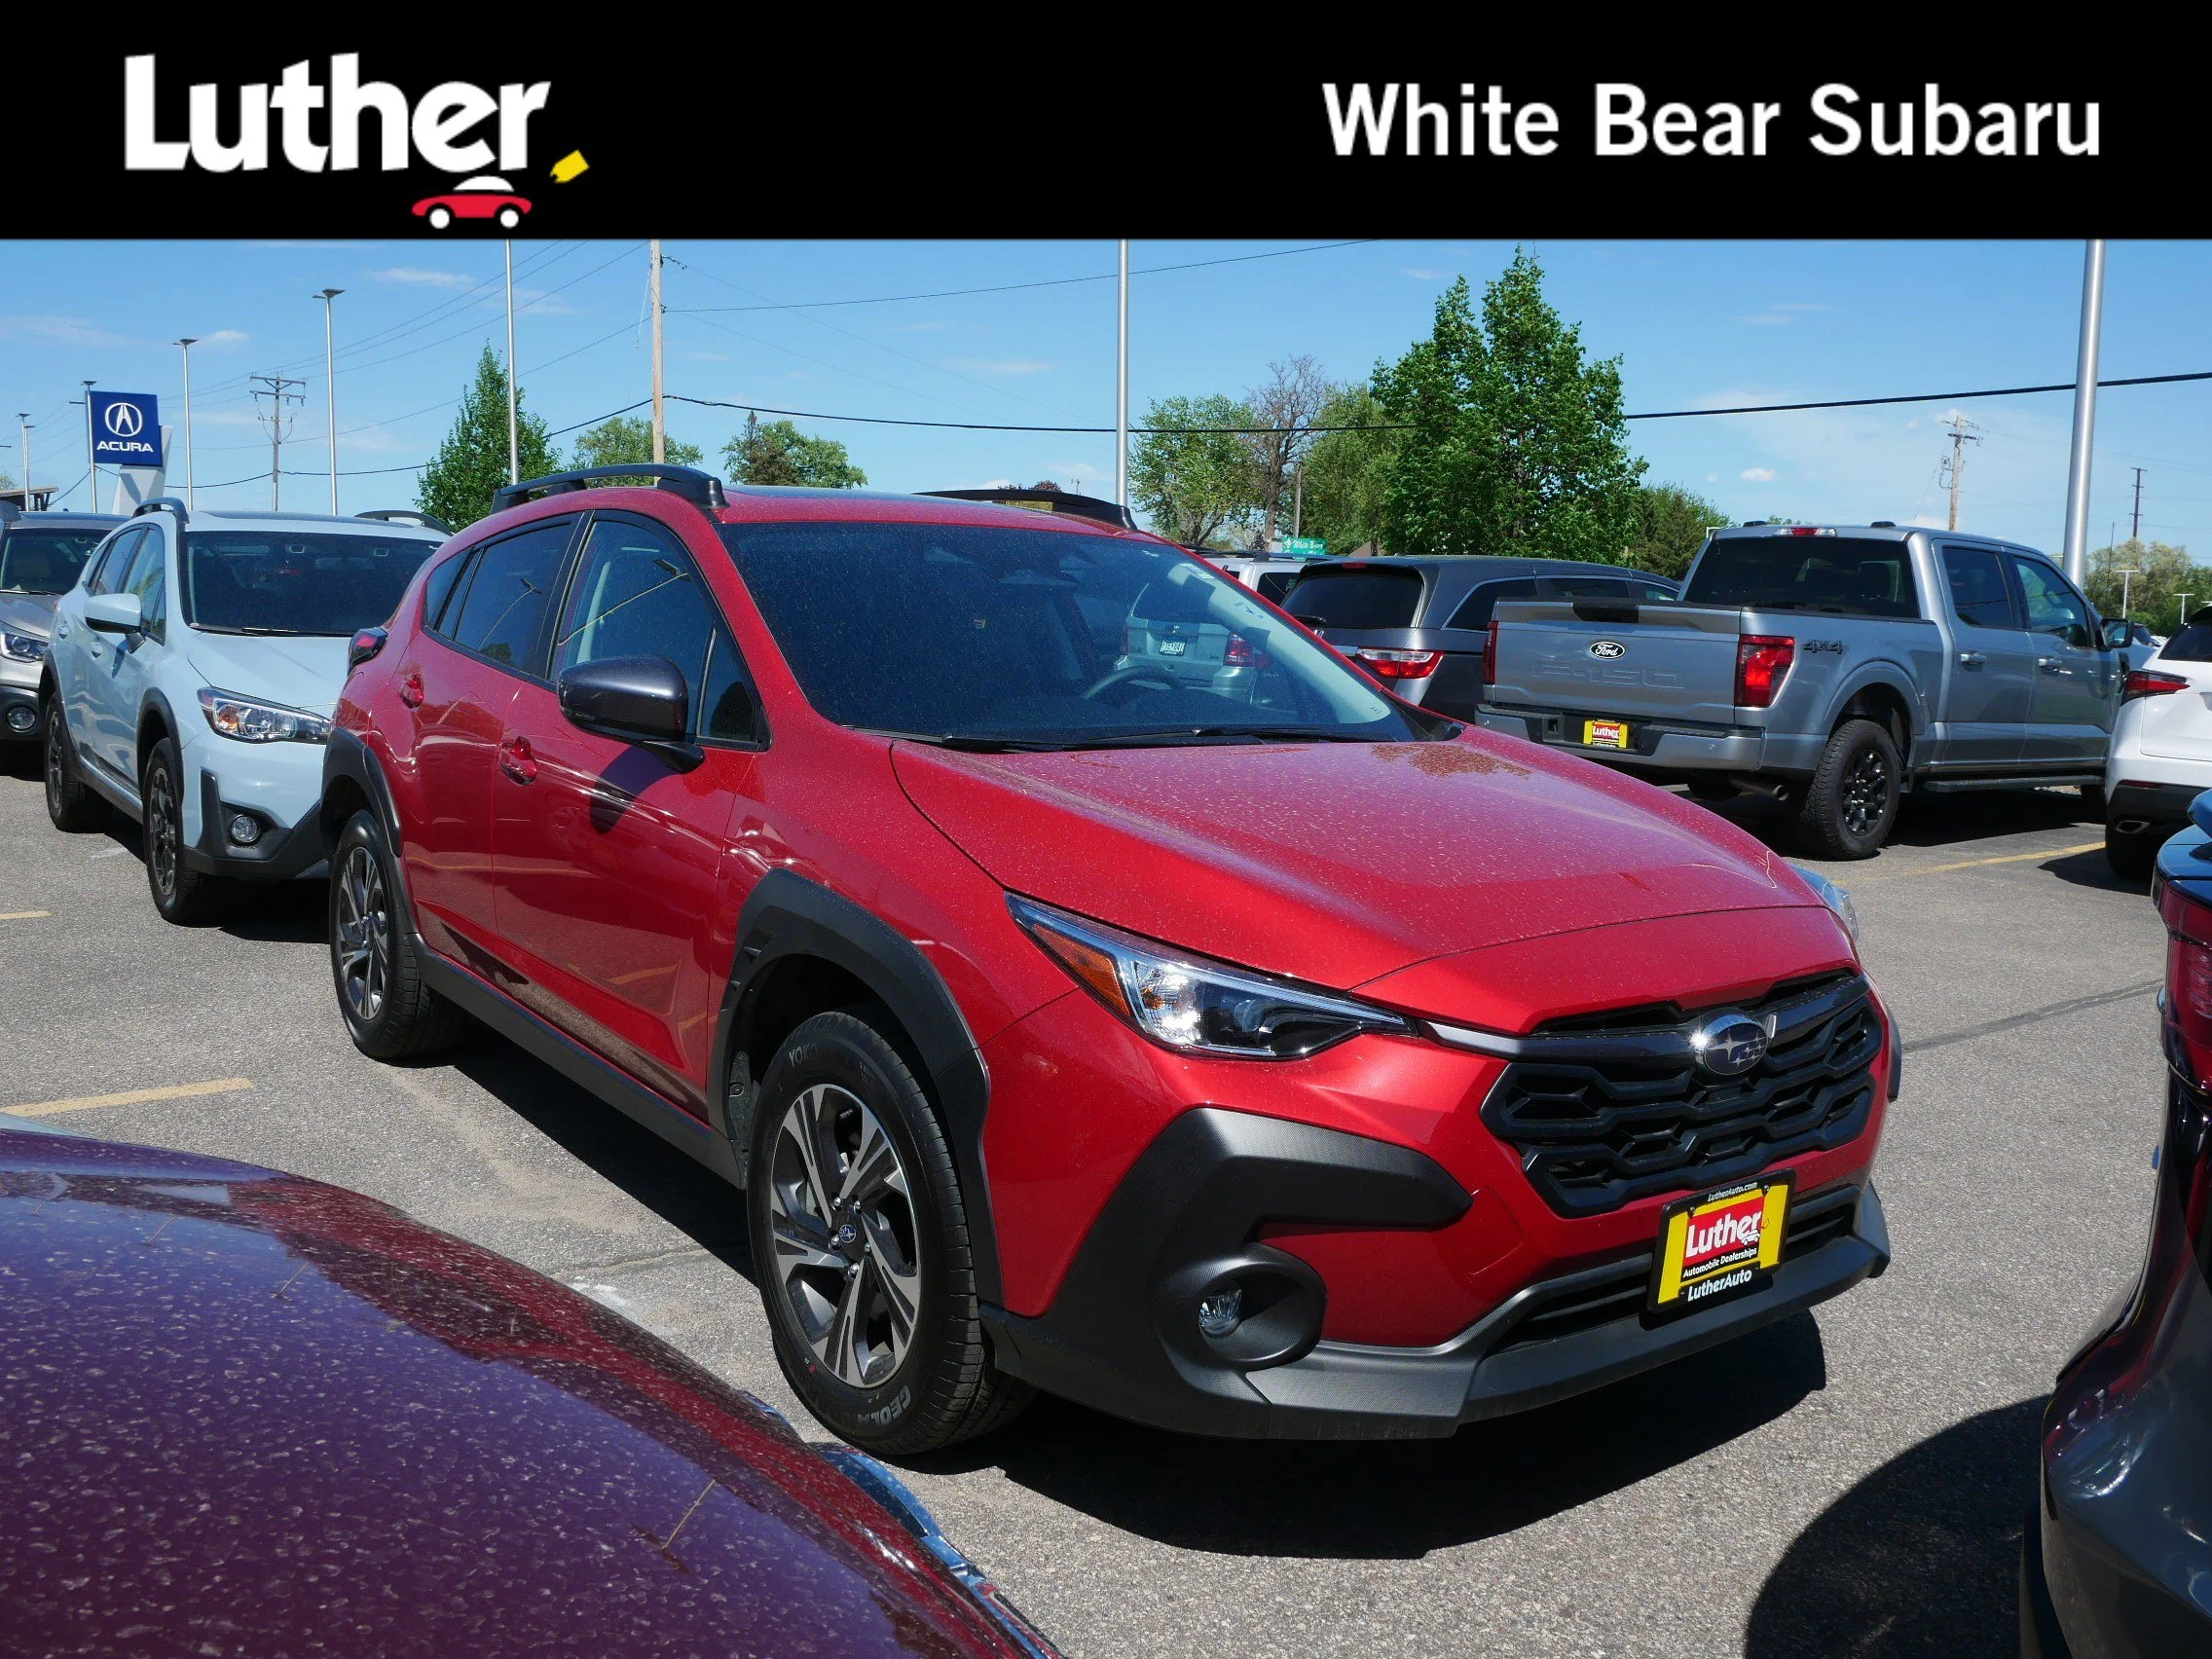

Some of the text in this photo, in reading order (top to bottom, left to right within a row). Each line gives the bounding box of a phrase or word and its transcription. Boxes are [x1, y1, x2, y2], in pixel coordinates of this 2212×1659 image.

[96, 440, 154, 453] ACURA
[1595, 644, 1618, 657] Ford
[1592, 725, 1620, 740] Luther
[1708, 1182, 1758, 1202] LutherAuto.com
[1685, 1211, 1762, 1258] Luther
[1682, 1247, 1757, 1278] Automobile Dealerships
[1687, 1269, 1753, 1302] LutherAuto
